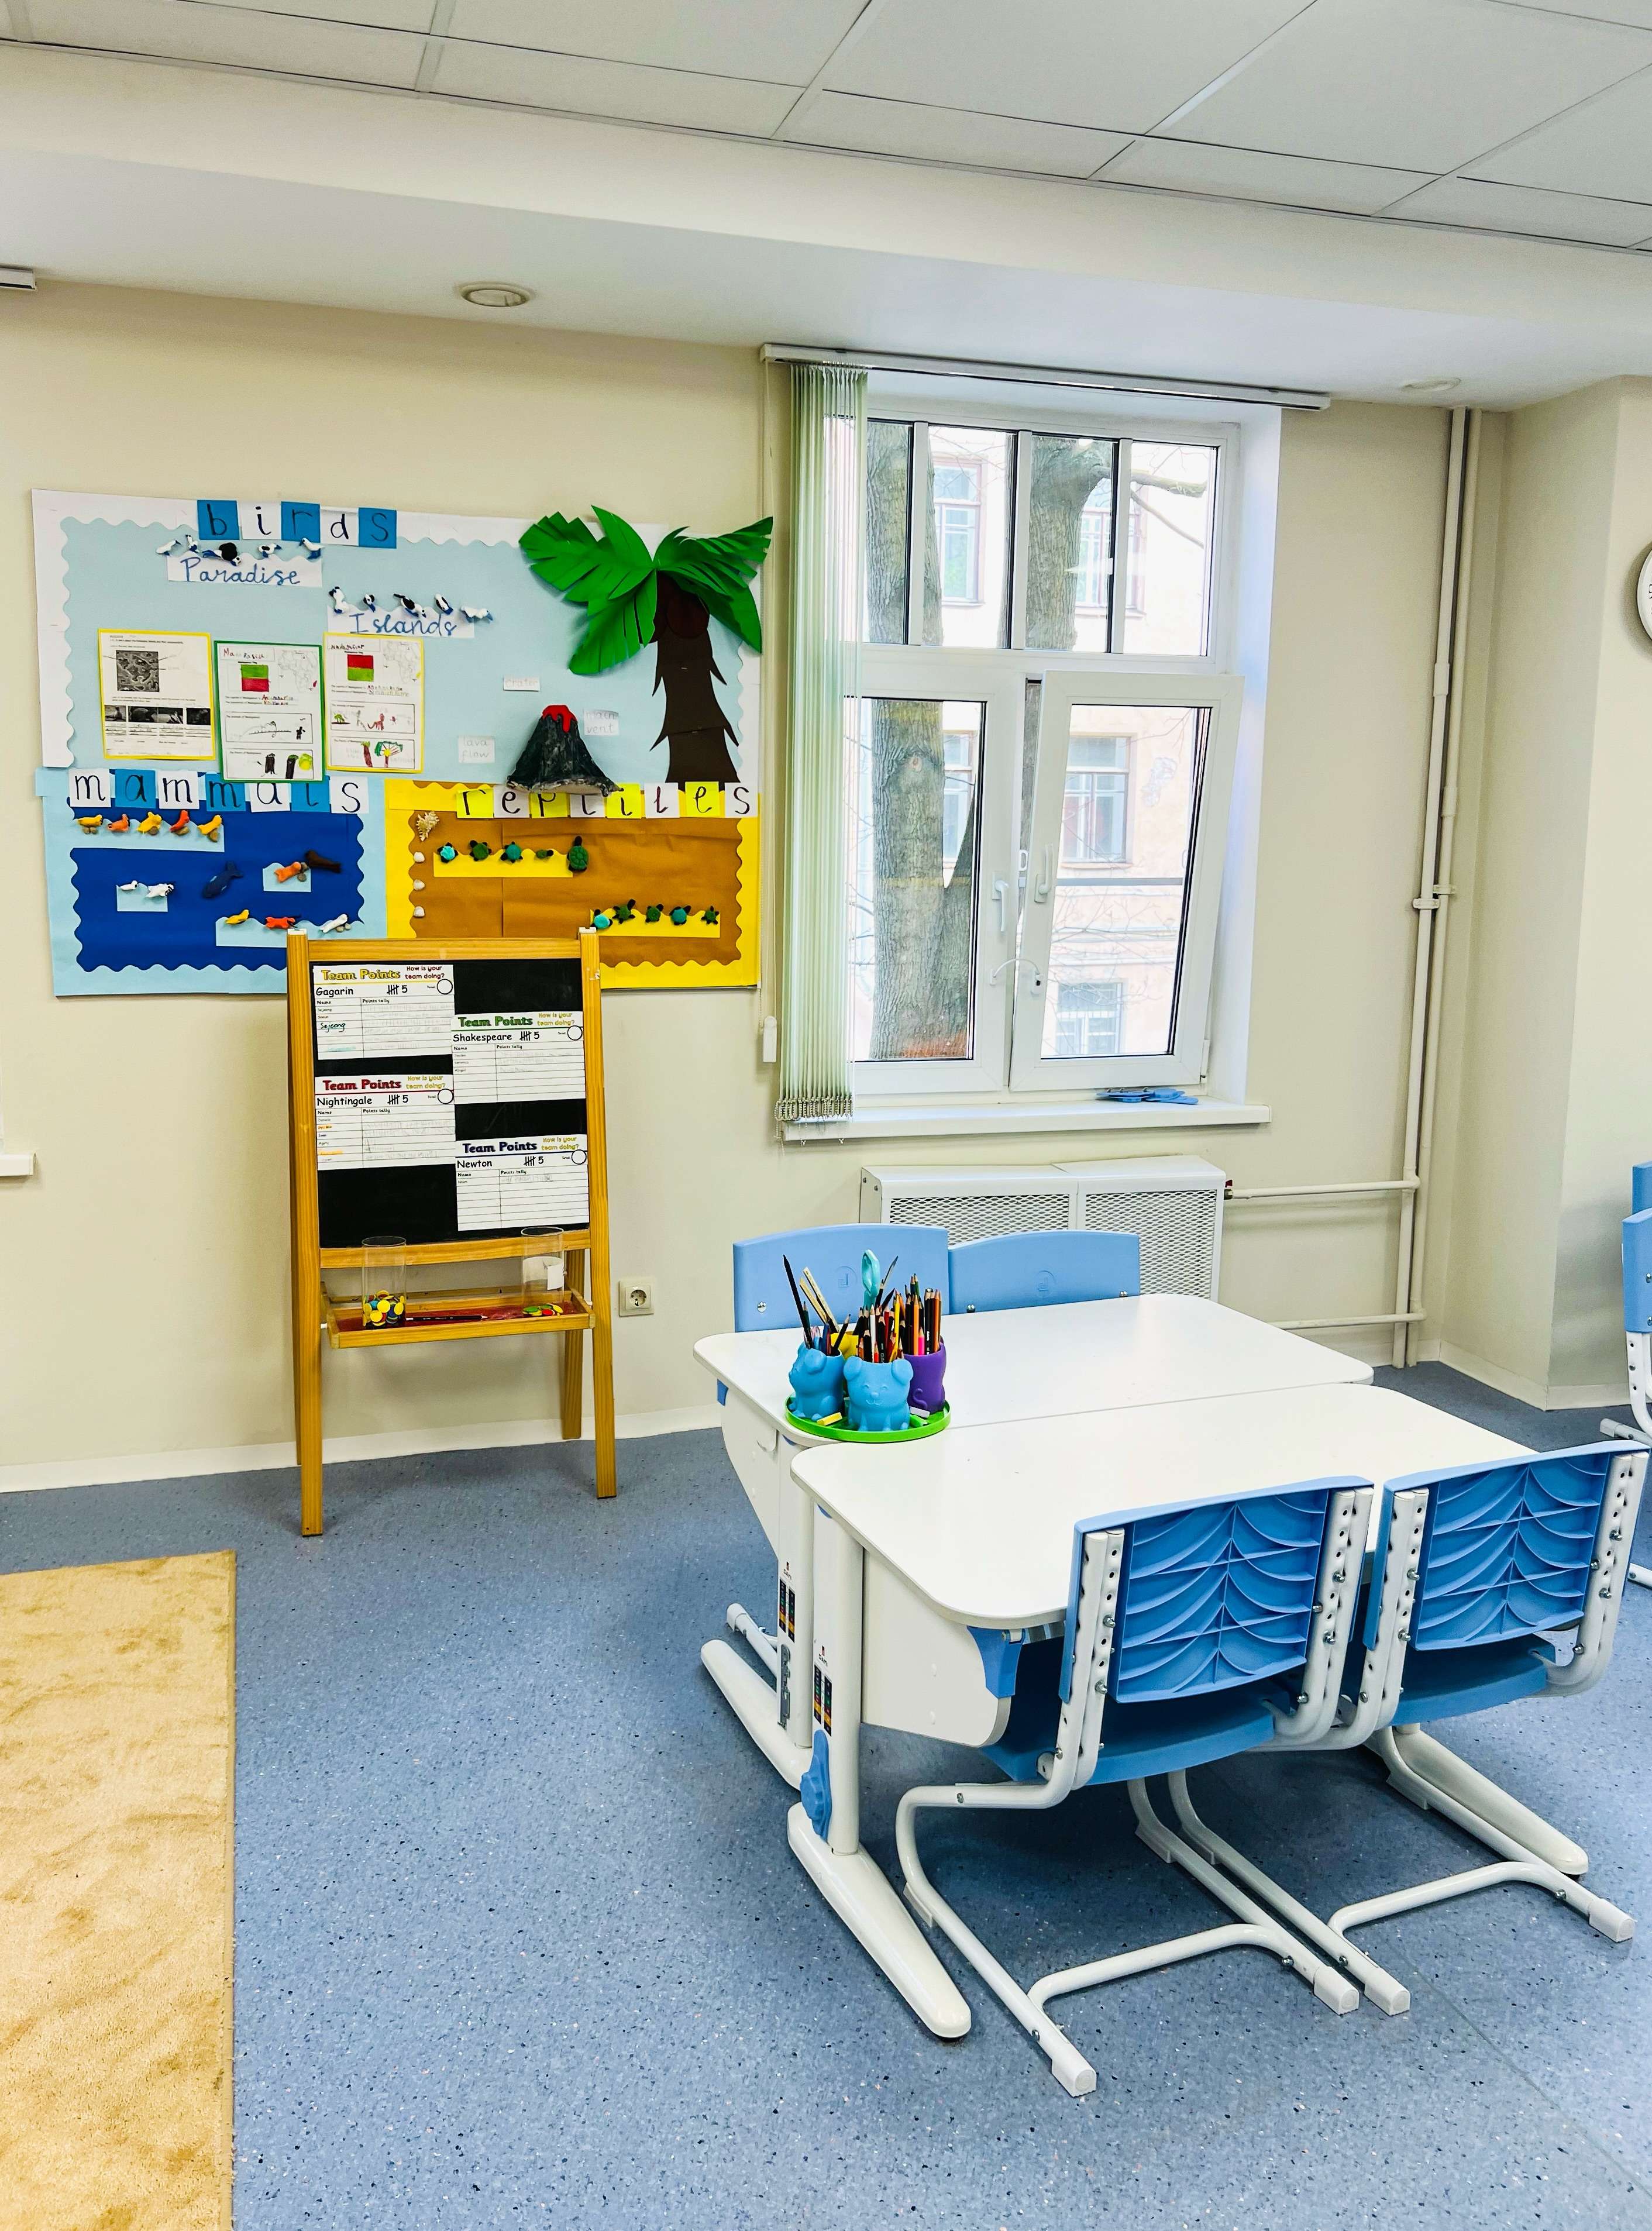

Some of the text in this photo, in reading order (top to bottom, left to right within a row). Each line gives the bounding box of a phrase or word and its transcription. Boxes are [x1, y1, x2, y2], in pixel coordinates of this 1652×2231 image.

[206, 503, 389, 542] birds
[180, 556, 300, 585] Paradise
[349, 612, 457, 636] Islands
[586, 722, 614, 734] vent
[463, 736, 487, 746] lava
[75, 774, 361, 812] mammals
[321, 969, 401, 980] Team Points
[316, 984, 408, 997] Gagarin 5
[321, 1022, 346, 1032] Sejeong
[458, 1015, 534, 1027] Team Points
[453, 1031, 540, 1043] Shakespeare 5
[322, 1079, 401, 1091] Team Points
[317, 1094, 409, 1107] Nightingale 5
[462, 1141, 537, 1153] Team Points
[457, 1156, 544, 1168] Newton 5
